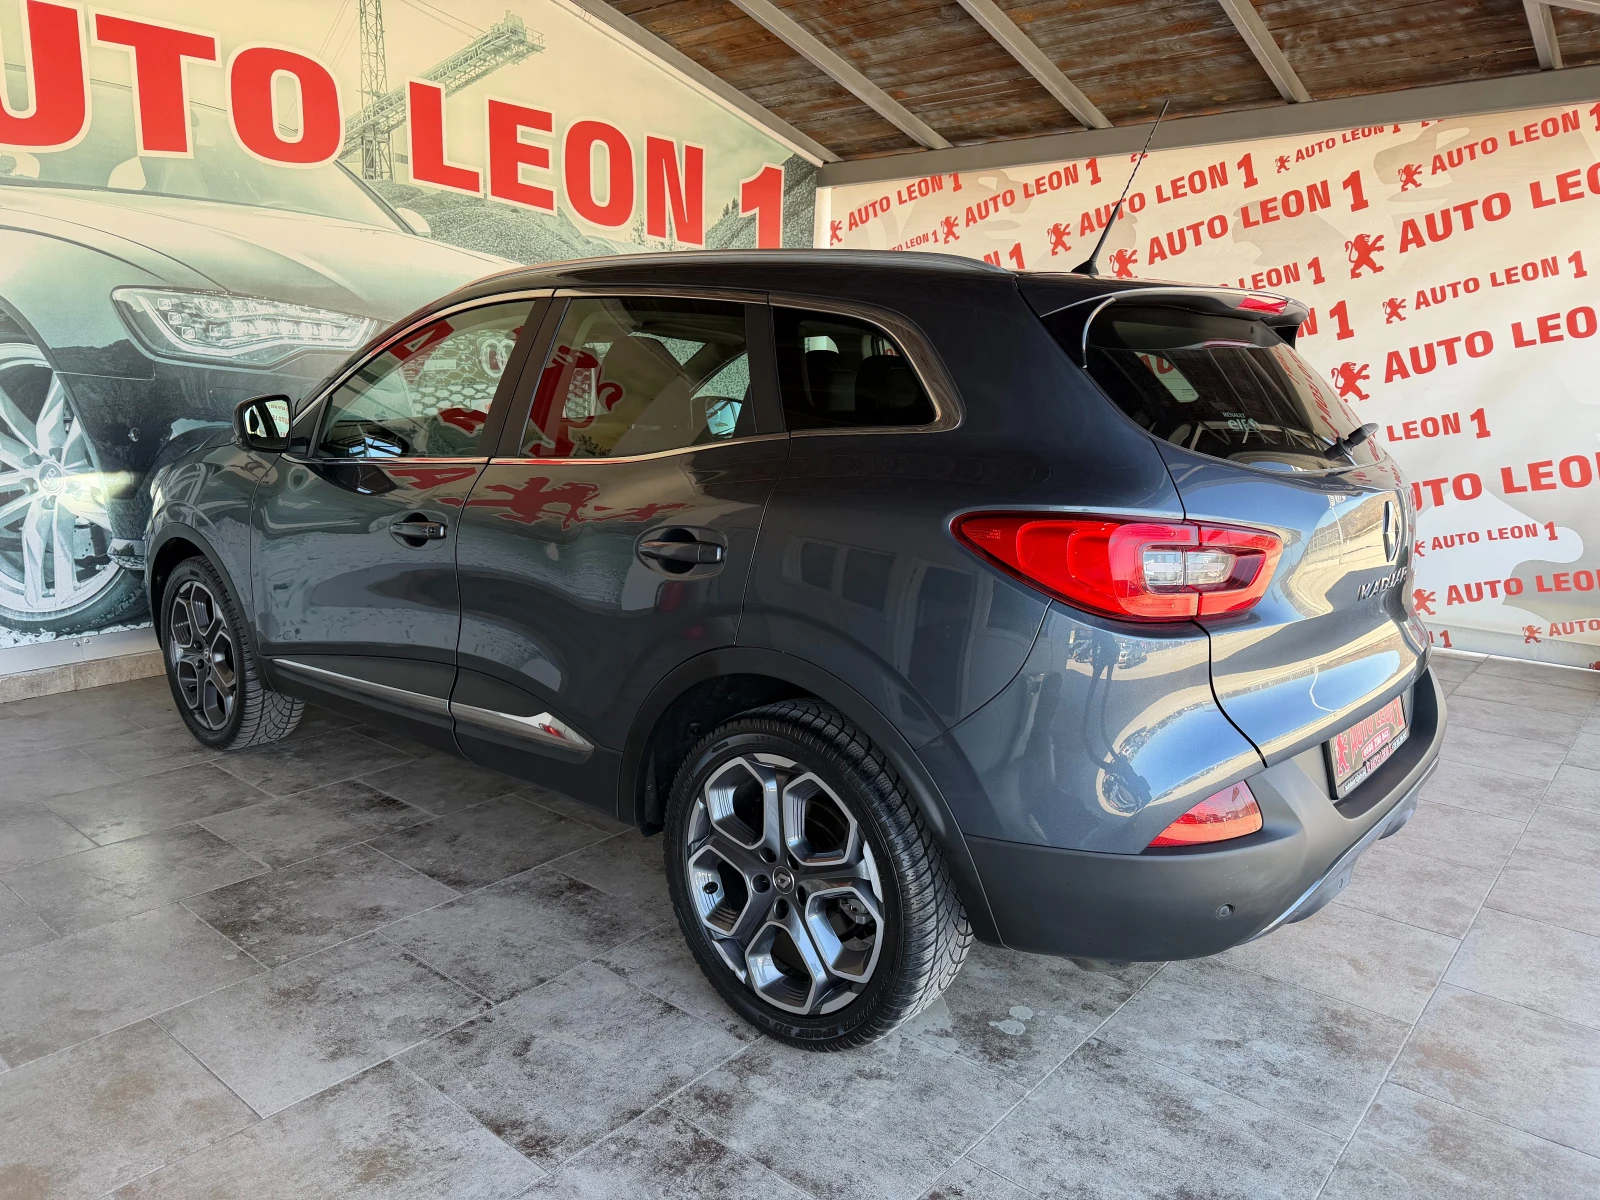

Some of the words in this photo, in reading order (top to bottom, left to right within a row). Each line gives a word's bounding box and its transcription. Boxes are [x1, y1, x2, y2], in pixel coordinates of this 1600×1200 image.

[1295, 137, 1337, 163] AUTO
[1341, 125, 1385, 145] LEON
[1431, 136, 1499, 176] AUTO
[1507, 109, 1581, 148] LEON
[408, 80, 705, 246] LEON
[740, 165, 783, 250] 1
[847, 195, 892, 232] AUTO
[896, 174, 945, 206] LEON
[947, 172, 963, 193] 1
[964, 188, 1017, 228] AUTO
[1021, 162, 1080, 200] LEON
[1084, 157, 1103, 186] 1
[1079, 191, 1147, 238] AUTO
[1154, 160, 1229, 205] LEON
[1236, 152, 1259, 189] 1
[1147, 214, 1229, 266] AUTO
[1239, 179, 1332, 230] LEON
[1341, 169, 1370, 213] 1
[1399, 191, 1512, 254] AUTO
[905, 232, 930, 250] LEON
[931, 229, 940, 244] 1
[1008, 242, 1026, 270] 1
[1238, 261, 1301, 291] LEON
[1306, 256, 1326, 286] 1
[1415, 277, 1481, 311] AUTO
[1489, 255, 1560, 288] LEON
[1567, 250, 1588, 279] 1
[1328, 299, 1355, 341] 1
[1384, 330, 1495, 384] AUTO
[1510, 305, 1598, 349] LEO
[1386, 411, 1462, 443] LEON
[1469, 407, 1491, 439] 1
[1500, 451, 1600, 495] LEO
[1431, 531, 1480, 551] AUTO
[1487, 523, 1539, 541] LEON
[1544, 521, 1558, 541] 1
[1447, 577, 1524, 606] AUTO
[1535, 568, 1600, 593] LEO
[1440, 630, 1452, 648] 1
[1548, 619, 1600, 637] AUTO
